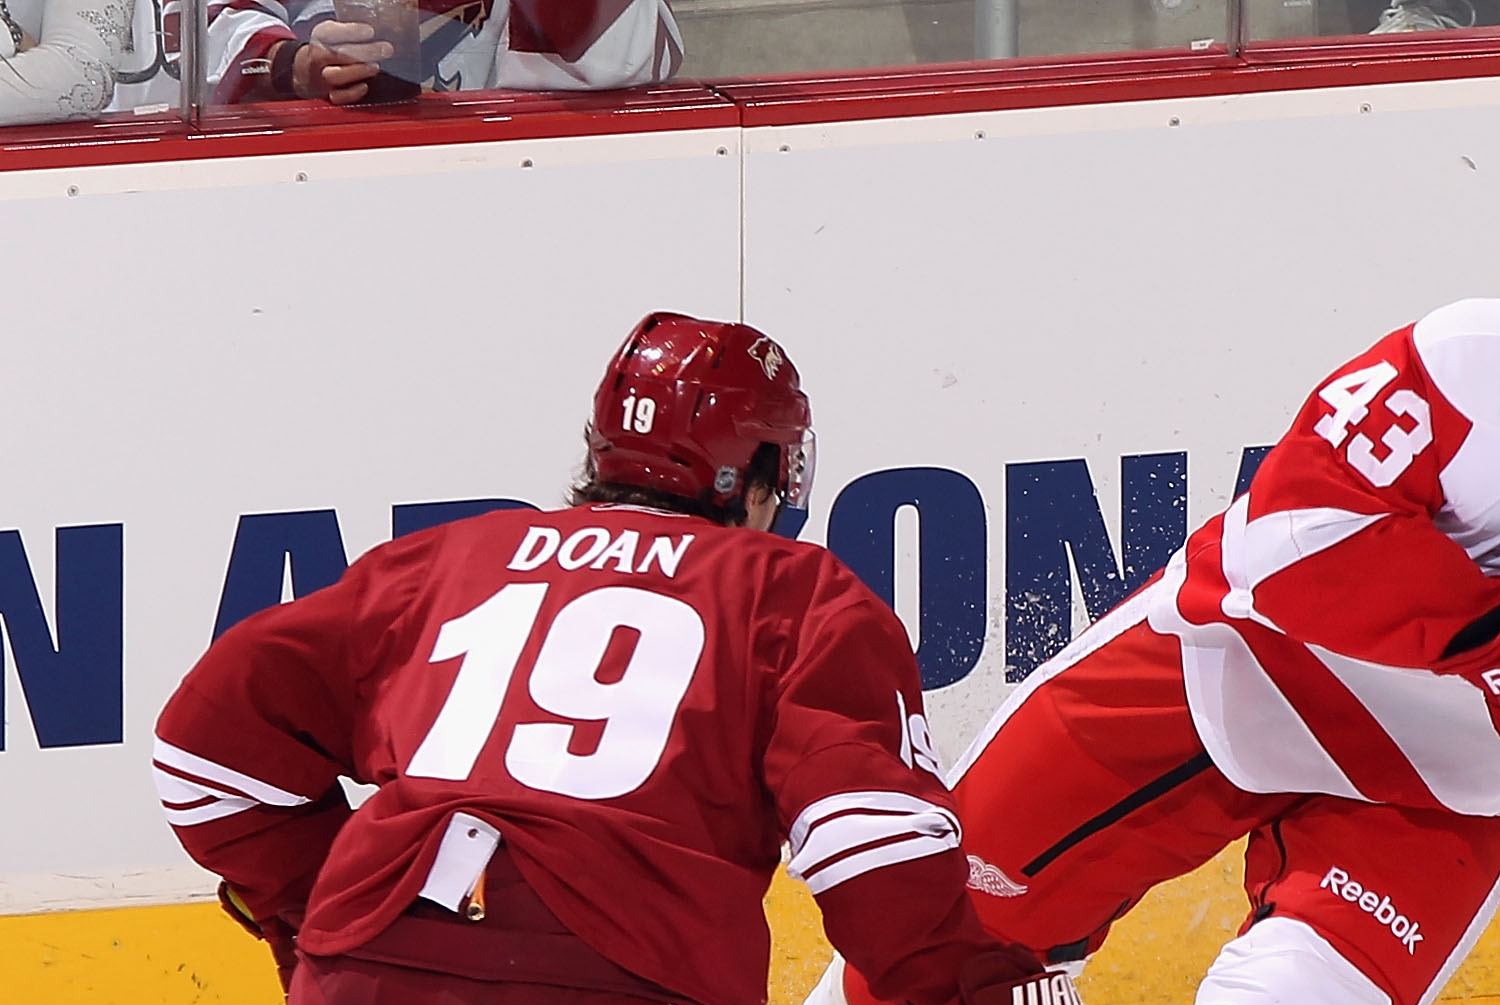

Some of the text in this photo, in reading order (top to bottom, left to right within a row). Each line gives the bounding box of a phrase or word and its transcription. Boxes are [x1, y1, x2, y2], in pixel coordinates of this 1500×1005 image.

[621, 394, 657, 434] 19
[1312, 359, 1434, 488] 43
[506, 525, 696, 579] DOAN
[405, 581, 704, 800] 19
[1319, 865, 1425, 956] Reebok
